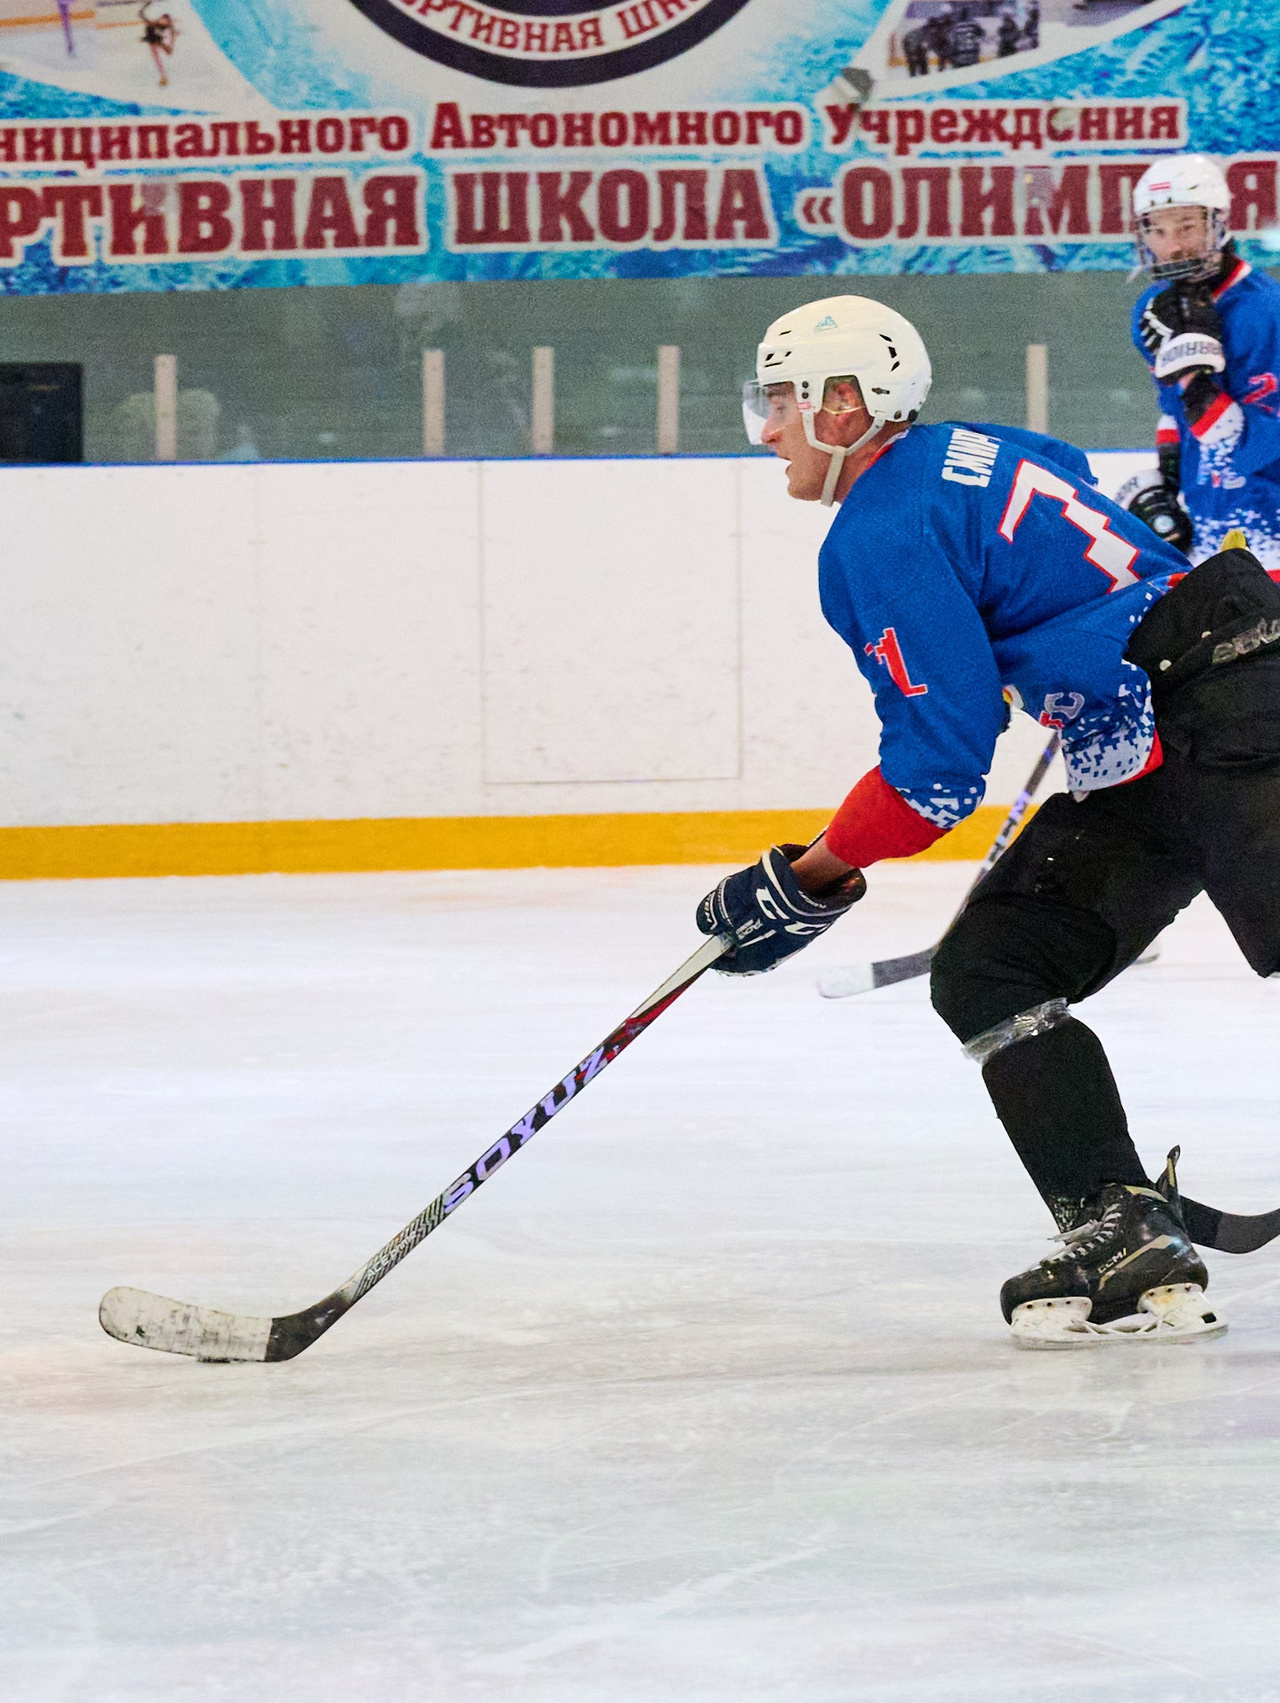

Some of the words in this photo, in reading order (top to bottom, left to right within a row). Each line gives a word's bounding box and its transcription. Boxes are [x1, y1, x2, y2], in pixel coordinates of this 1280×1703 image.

[401, 0, 604, 52] РТИВНАЯ
[616, 0, 698, 39] ШК
[430, 102, 803, 150] Автономного
[453, 169, 771, 244] ШКОЛА
[941, 427, 1003, 488] СМИР
[443, 1045, 609, 1214] SOYUZ
